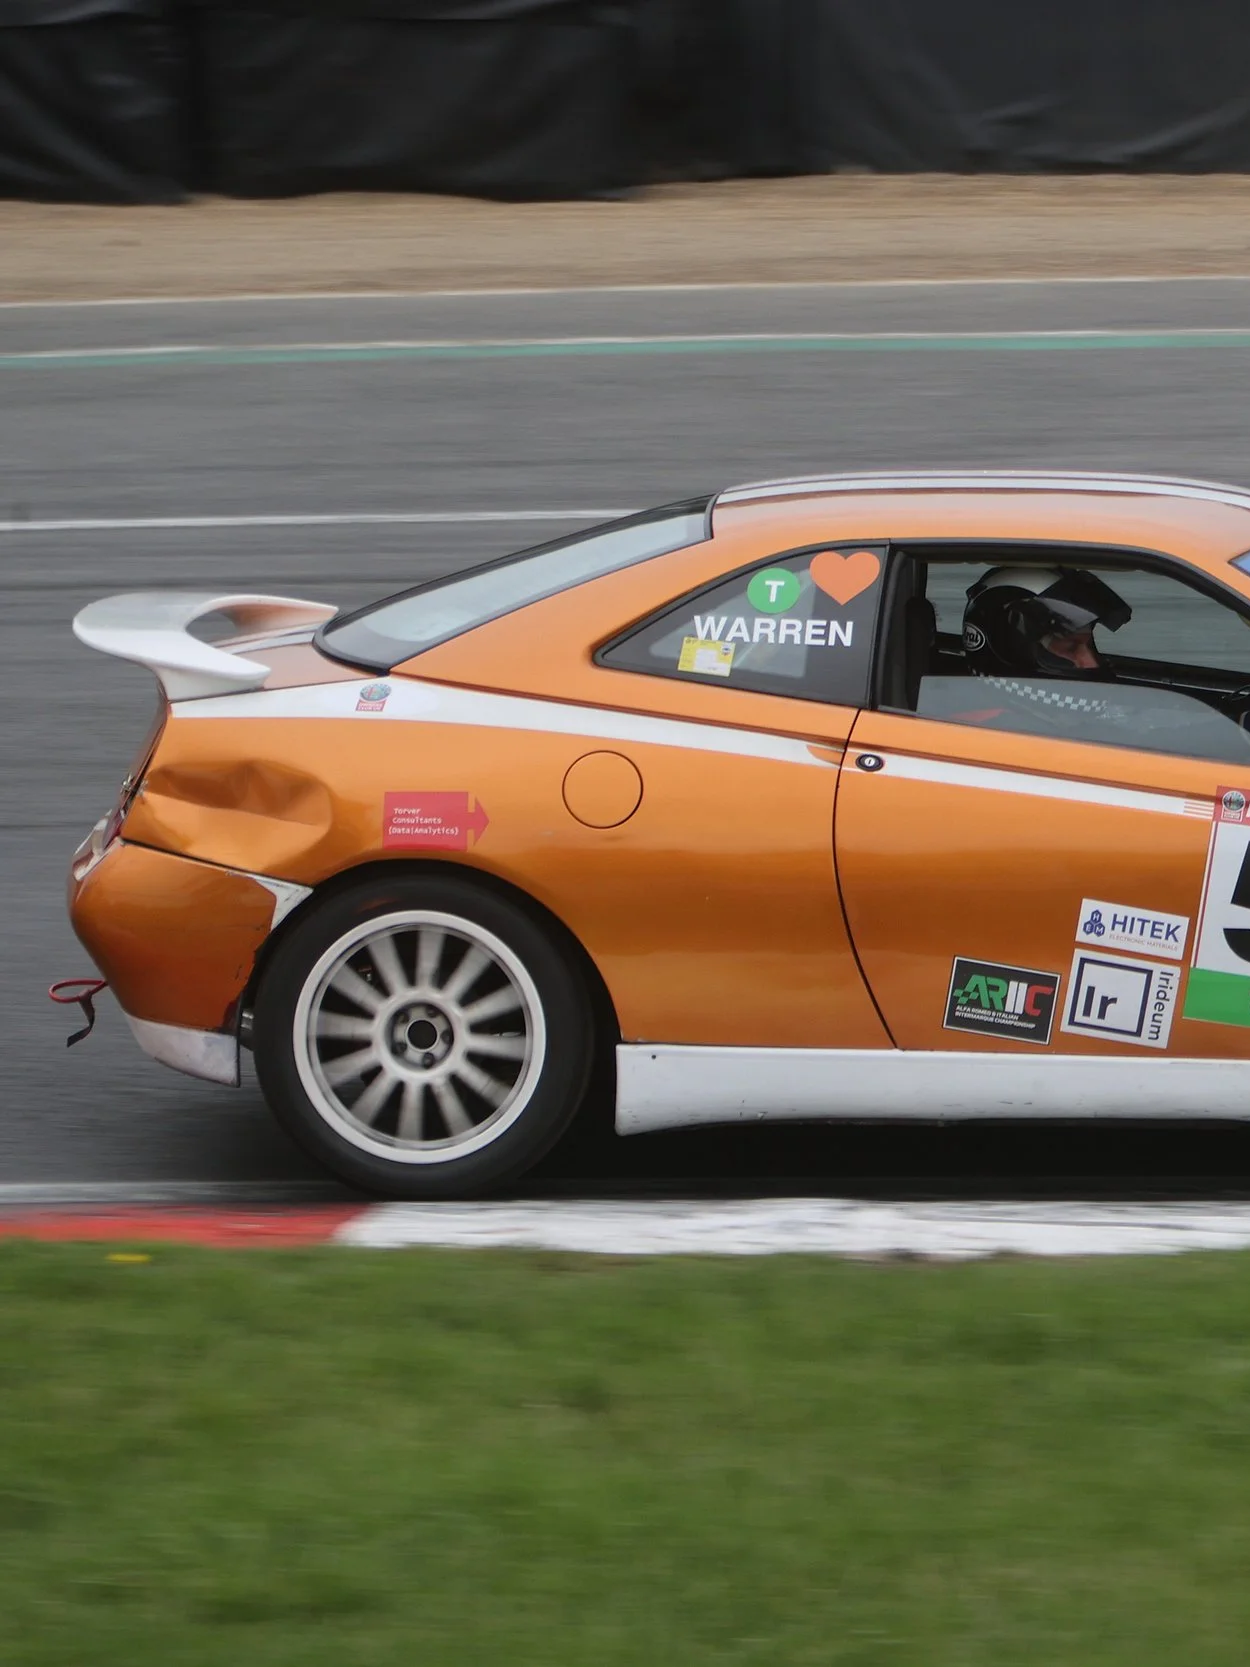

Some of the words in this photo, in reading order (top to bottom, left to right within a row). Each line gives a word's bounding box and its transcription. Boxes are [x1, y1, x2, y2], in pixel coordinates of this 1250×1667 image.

[765, 580, 784, 602] T
[693, 615, 853, 647] WARREN
[392, 816, 442, 824] Consultants
[393, 807, 421, 815] Torver
[1111, 913, 1181, 942] HITEK
[956, 1005, 971, 1013] ALFA
[996, 1012, 1019, 1021] ITALIAN
[1082, 985, 1118, 1020] Ir
[1148, 971, 1174, 1040] Irideum
